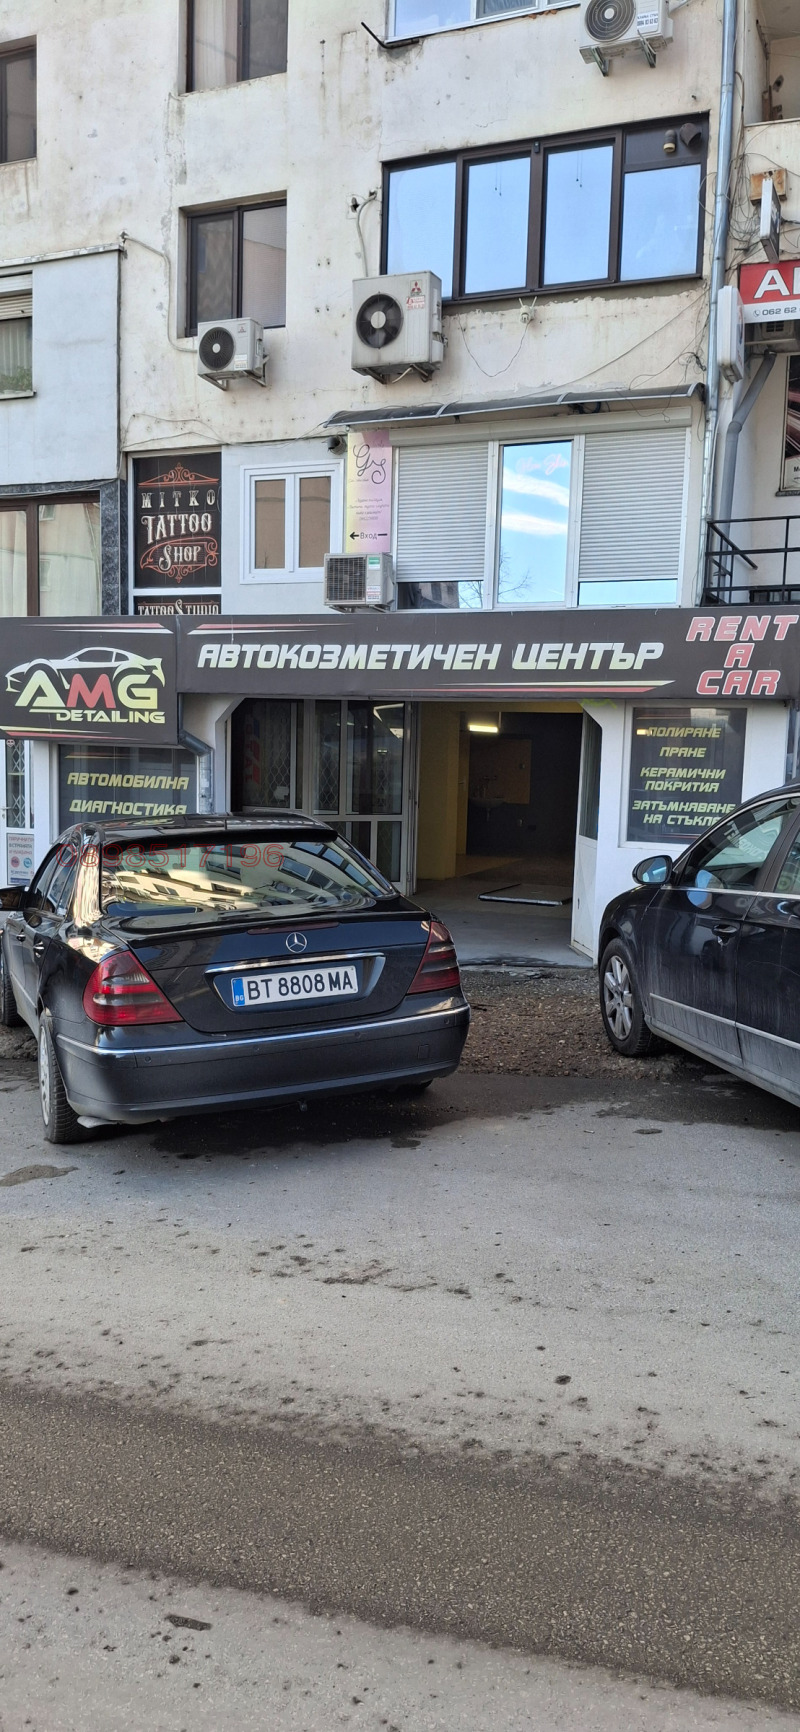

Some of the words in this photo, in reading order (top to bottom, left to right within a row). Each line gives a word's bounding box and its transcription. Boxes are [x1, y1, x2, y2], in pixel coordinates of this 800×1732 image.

[761, 308, 781, 316] 062
[784, 306, 797, 314] 62
[141, 489, 216, 509] MITKO
[140, 513, 212, 545] TATTOO
[359, 531, 378, 541] Вход
[685, 614, 800, 642] RENT
[197, 644, 502, 670] АВТОКОЗМЕТИЧЕН
[512, 642, 664, 670] ЦЕНТЪР
[723, 643, 755, 668] A
[15, 670, 158, 709] AMG
[696, 669, 781, 695] CAR
[56, 709, 166, 724] DETAILING
[646, 727, 722, 738] ПОЛИРАНЕ
[659, 746, 707, 758] ПРАНЕ
[67, 772, 190, 790] АВТОМОБИЛНА
[640, 767, 726, 779] КЕРАМИЧНИ
[644, 781, 720, 793] ПОКРИТИЯ
[69, 799, 187, 816] ДИАГНОСТИКА
[632, 800, 736, 813] ЗАТЪМНЯВАНЕ
[643, 814, 663, 824] НА
[247, 979, 272, 1001] BT
[278, 973, 325, 997] 8808
[328, 970, 354, 991] MA
